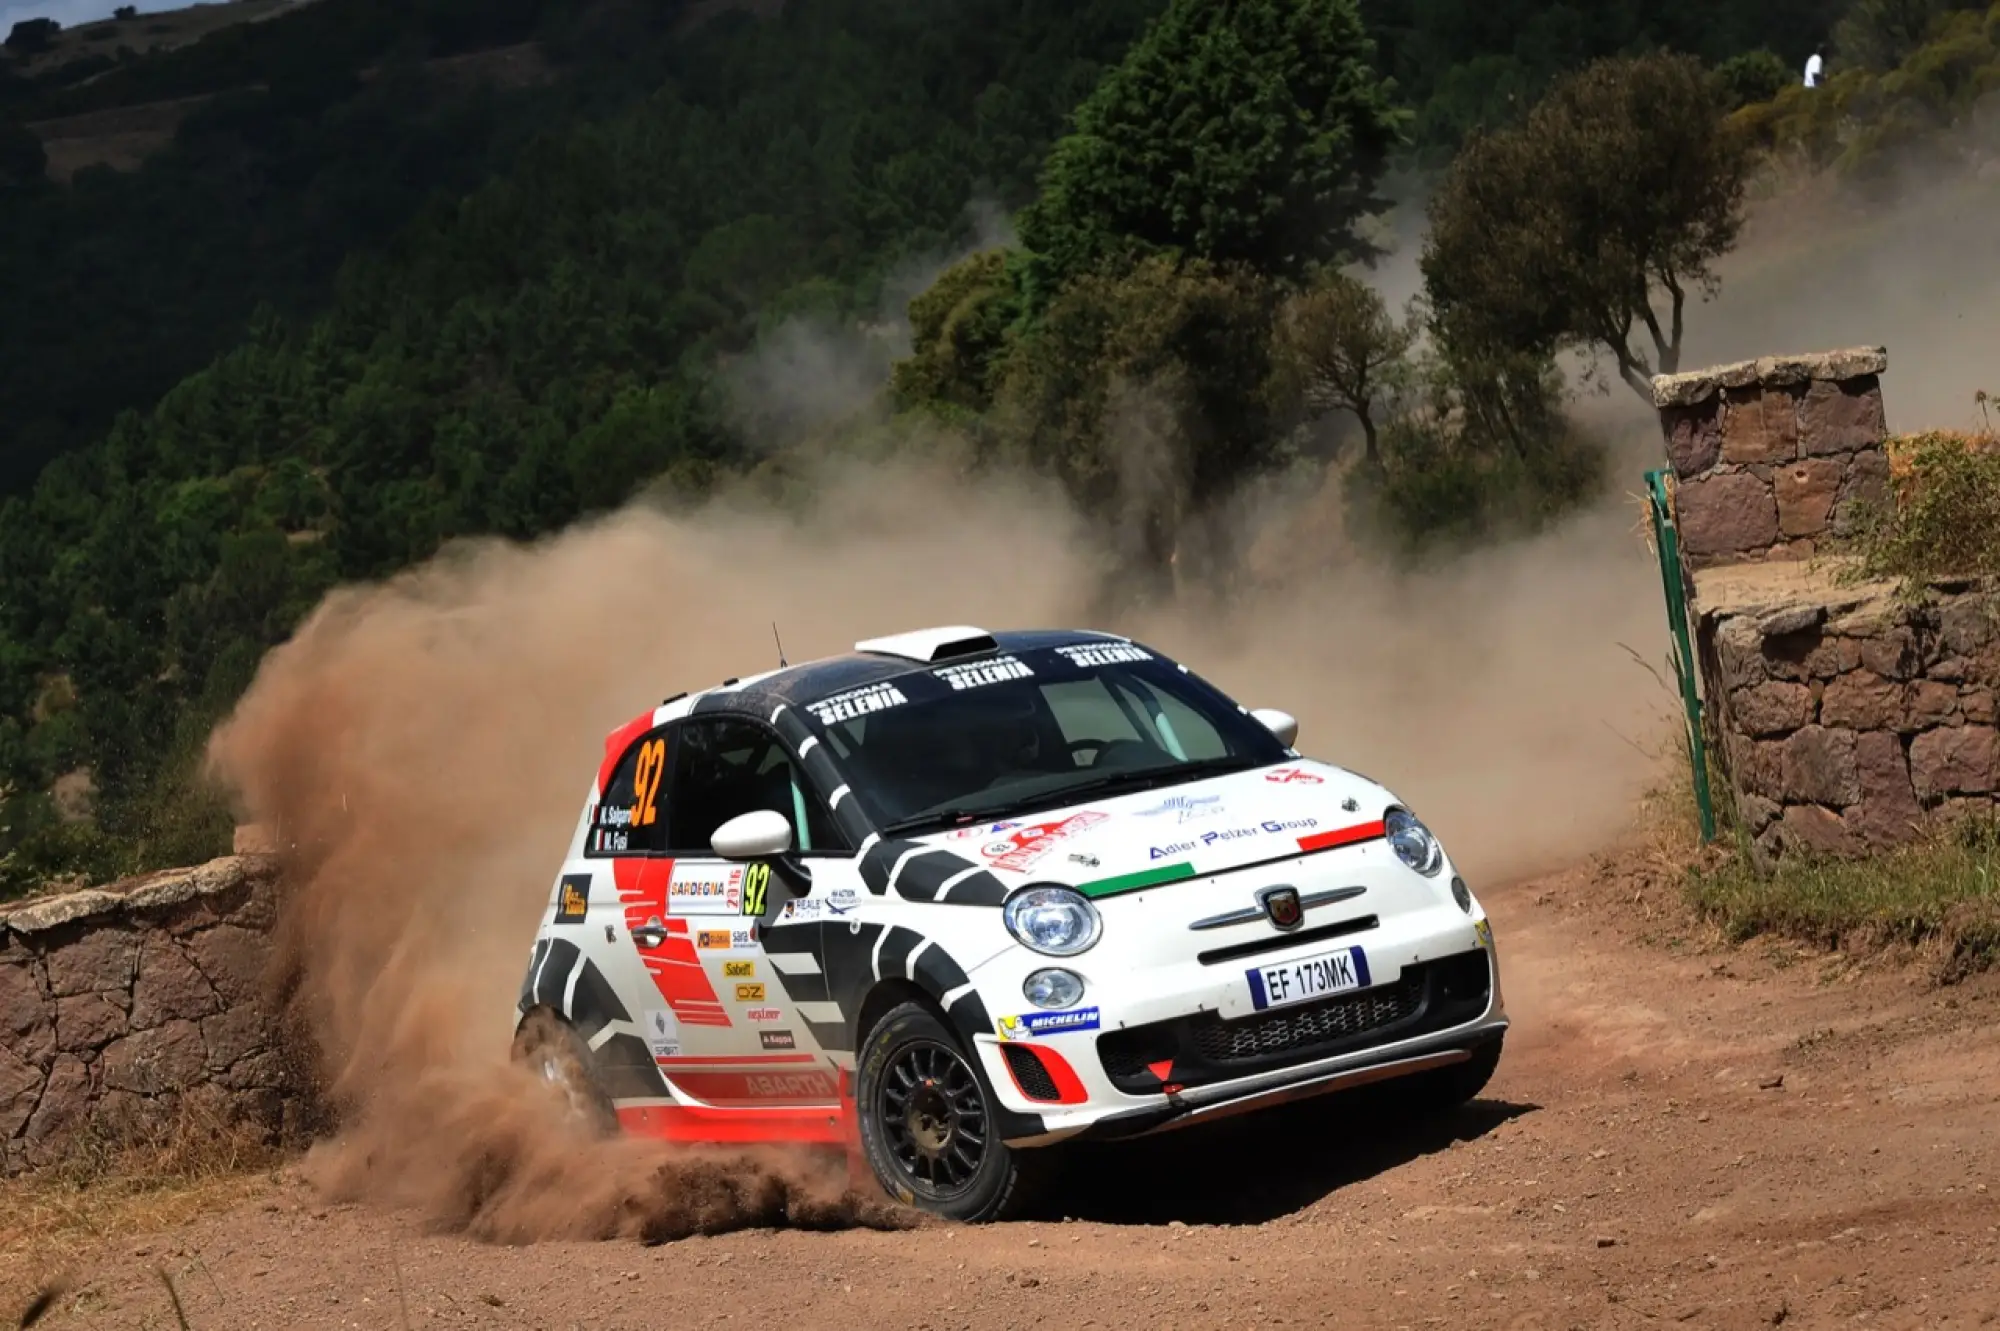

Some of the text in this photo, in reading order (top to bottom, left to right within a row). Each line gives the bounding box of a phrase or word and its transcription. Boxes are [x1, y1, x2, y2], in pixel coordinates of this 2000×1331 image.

[1071, 647, 1154, 667] SELENIA
[948, 661, 1035, 691] SELENIA
[819, 687, 908, 726] SELENIA
[631, 739, 665, 827] 92
[1149, 816, 1318, 860] Adler Pelzer Group
[671, 881, 725, 896] SARDEGNA
[726, 868, 742, 909] 2016
[744, 863, 770, 916] 92
[737, 986, 763, 998] OZ
[1266, 954, 1354, 1001] EF 173MK
[1031, 1010, 1098, 1028] MICHELIN
[745, 1074, 831, 1096] ABARTH
